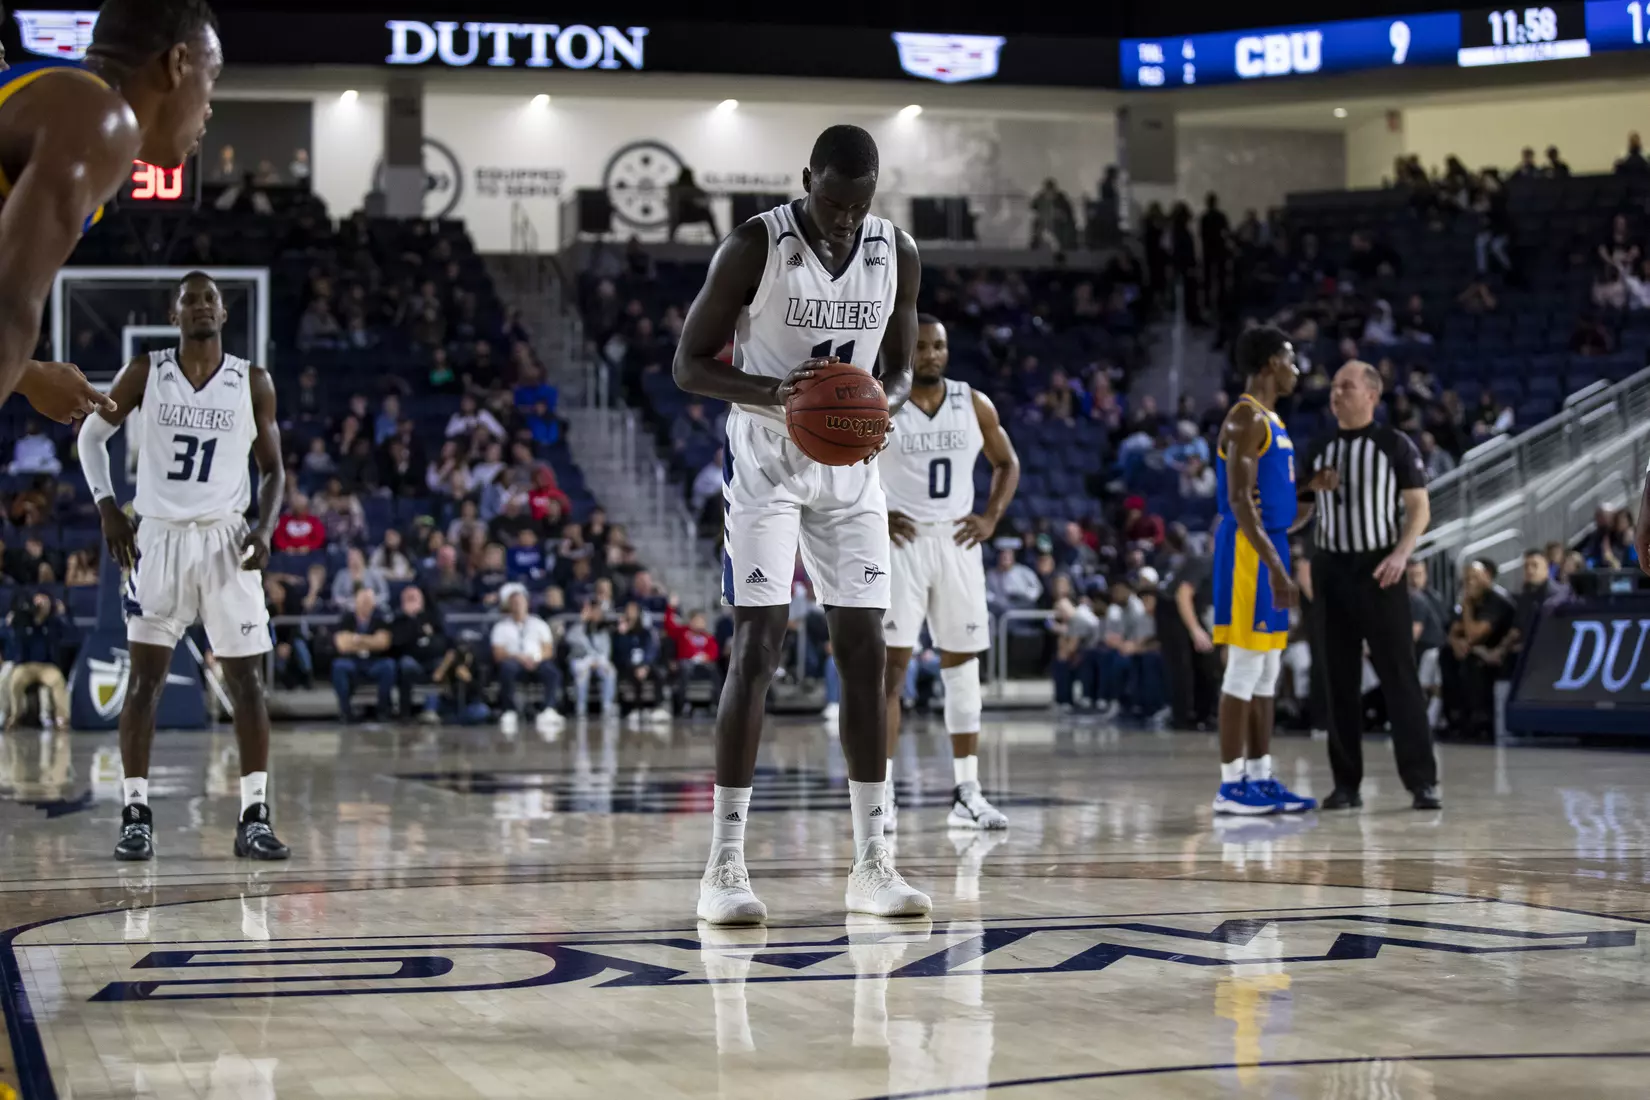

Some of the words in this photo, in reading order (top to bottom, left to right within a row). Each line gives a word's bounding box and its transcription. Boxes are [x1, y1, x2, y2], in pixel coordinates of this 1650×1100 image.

[1389, 21, 1411, 64] 9
[1488, 7, 1558, 45] 11:58
[1626, 1, 1650, 44] 1
[385, 20, 649, 70] DUTTON
[1235, 30, 1322, 78] CBU
[131, 159, 184, 199] 30
[864, 257, 886, 266] WAC
[785, 298, 882, 330] LANCERS
[158, 403, 234, 431] LANCERS
[167, 433, 218, 483] 31
[902, 430, 967, 455] LANCERS
[929, 457, 951, 499] 0
[1552, 619, 1650, 692] DU
